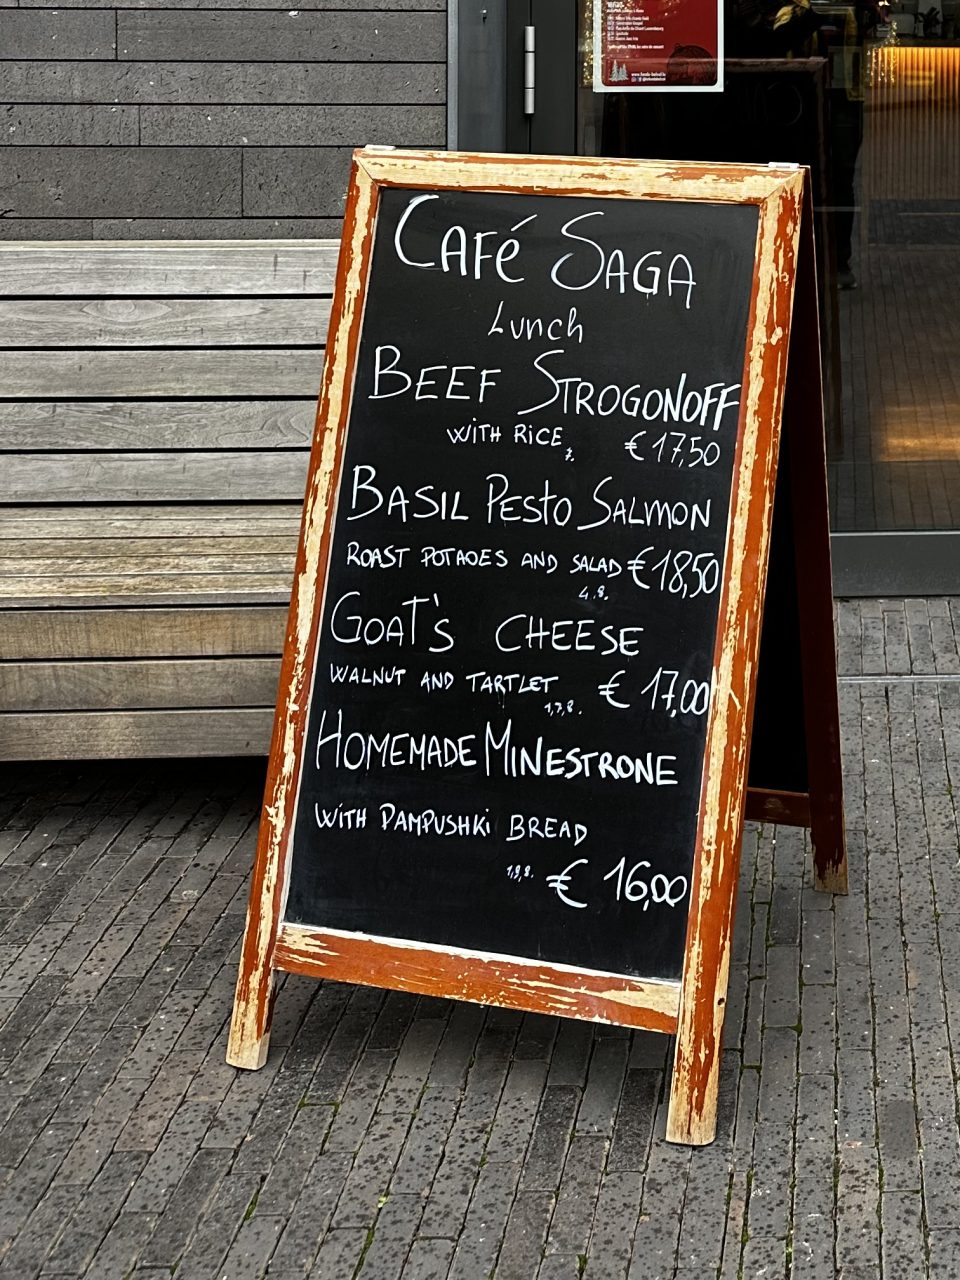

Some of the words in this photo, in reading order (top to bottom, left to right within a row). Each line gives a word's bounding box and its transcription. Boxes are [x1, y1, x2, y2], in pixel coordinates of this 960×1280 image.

[551, 211, 696, 309] SAGA
[488, 301, 582, 343] Lunch
[368, 345, 501, 402] BEEF
[517, 349, 742, 430] STROGONOFF
[347, 465, 469, 521] BASIL
[577, 476, 711, 531] SALMON
[347, 542, 410, 569] ROAST
[521, 551, 558, 574] AND
[569, 554, 622, 578] SALAD
[496, 614, 644, 657] CHEESE
[330, 664, 407, 686] WALNUT
[420, 674, 454, 694] AND
[466, 673, 559, 694] TARTLET
[315, 709, 476, 771] HOMEMADE
[485, 719, 678, 786] MINESTRONE
[506, 815, 588, 845] BREAD
